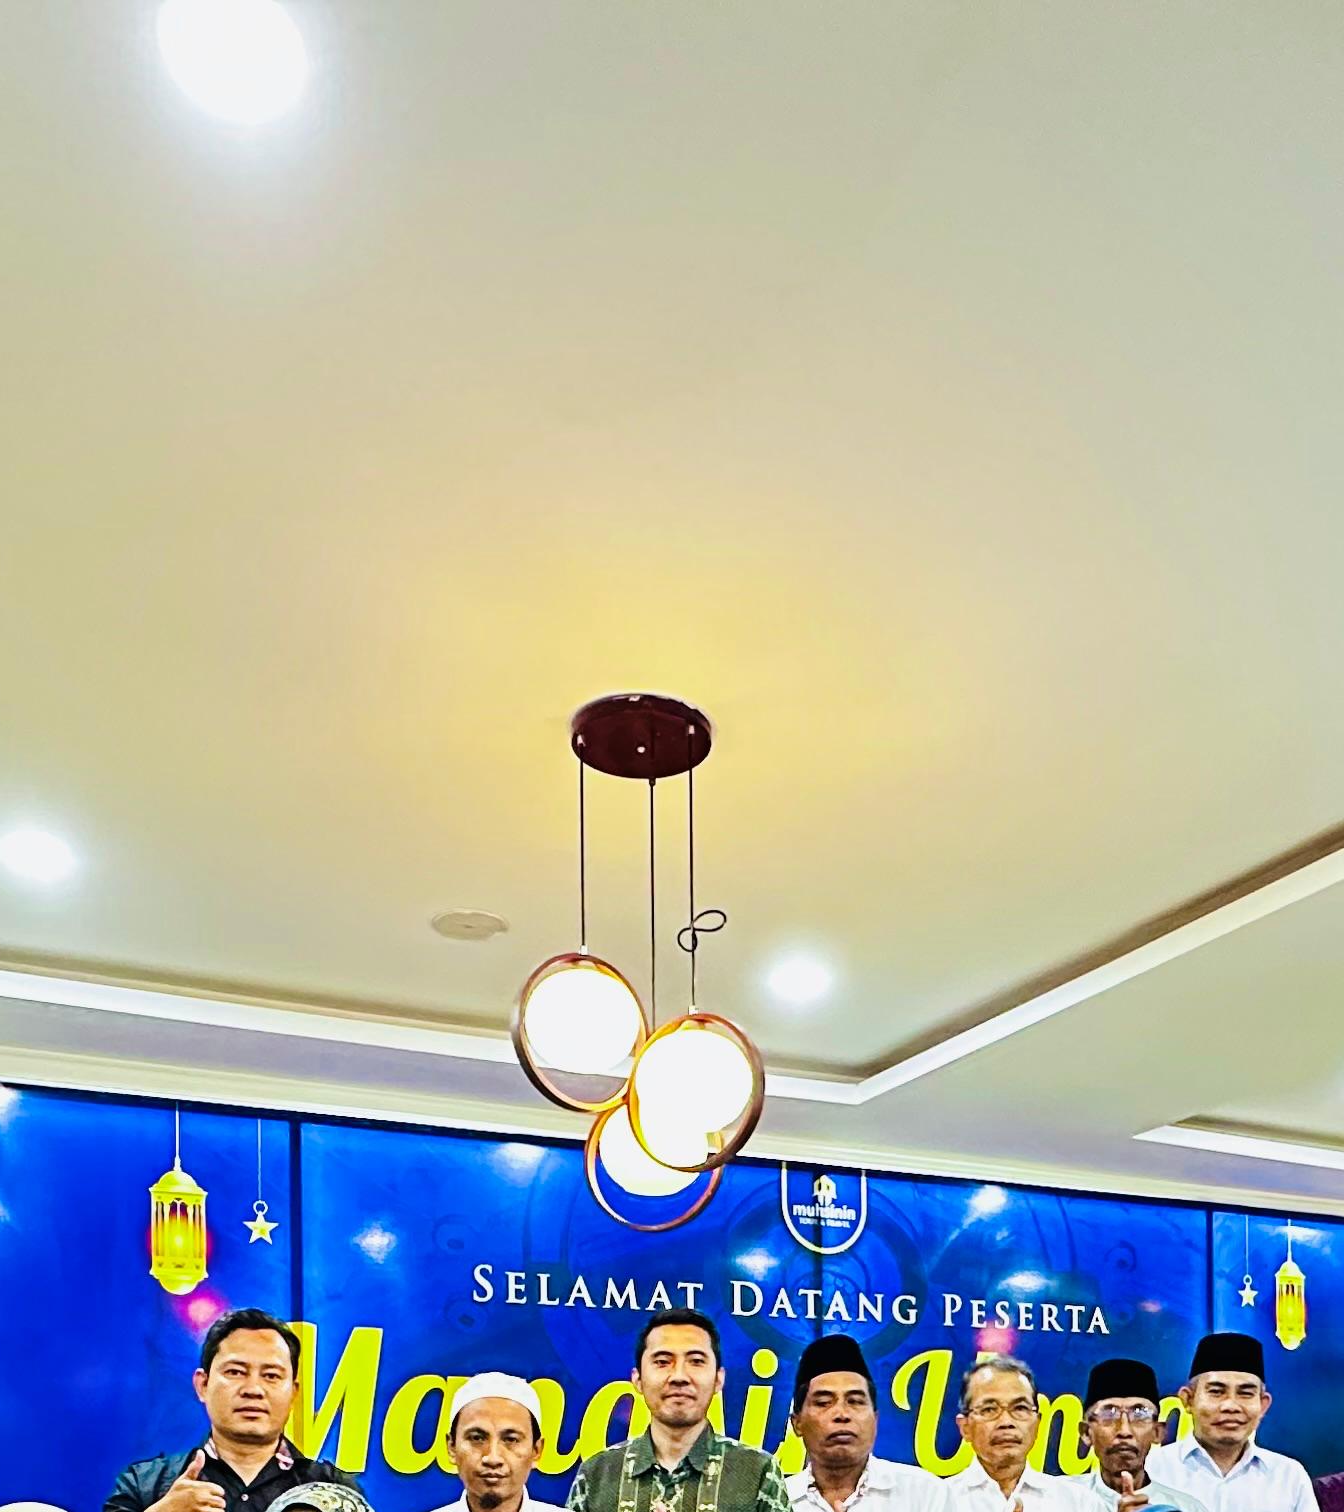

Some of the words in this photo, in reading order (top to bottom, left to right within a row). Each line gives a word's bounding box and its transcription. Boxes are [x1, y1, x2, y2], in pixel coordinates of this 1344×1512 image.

[472, 1264, 704, 1312] SELAMAT
[729, 1279, 918, 1326] DATANG
[942, 1293, 1110, 1335] PESERTA
